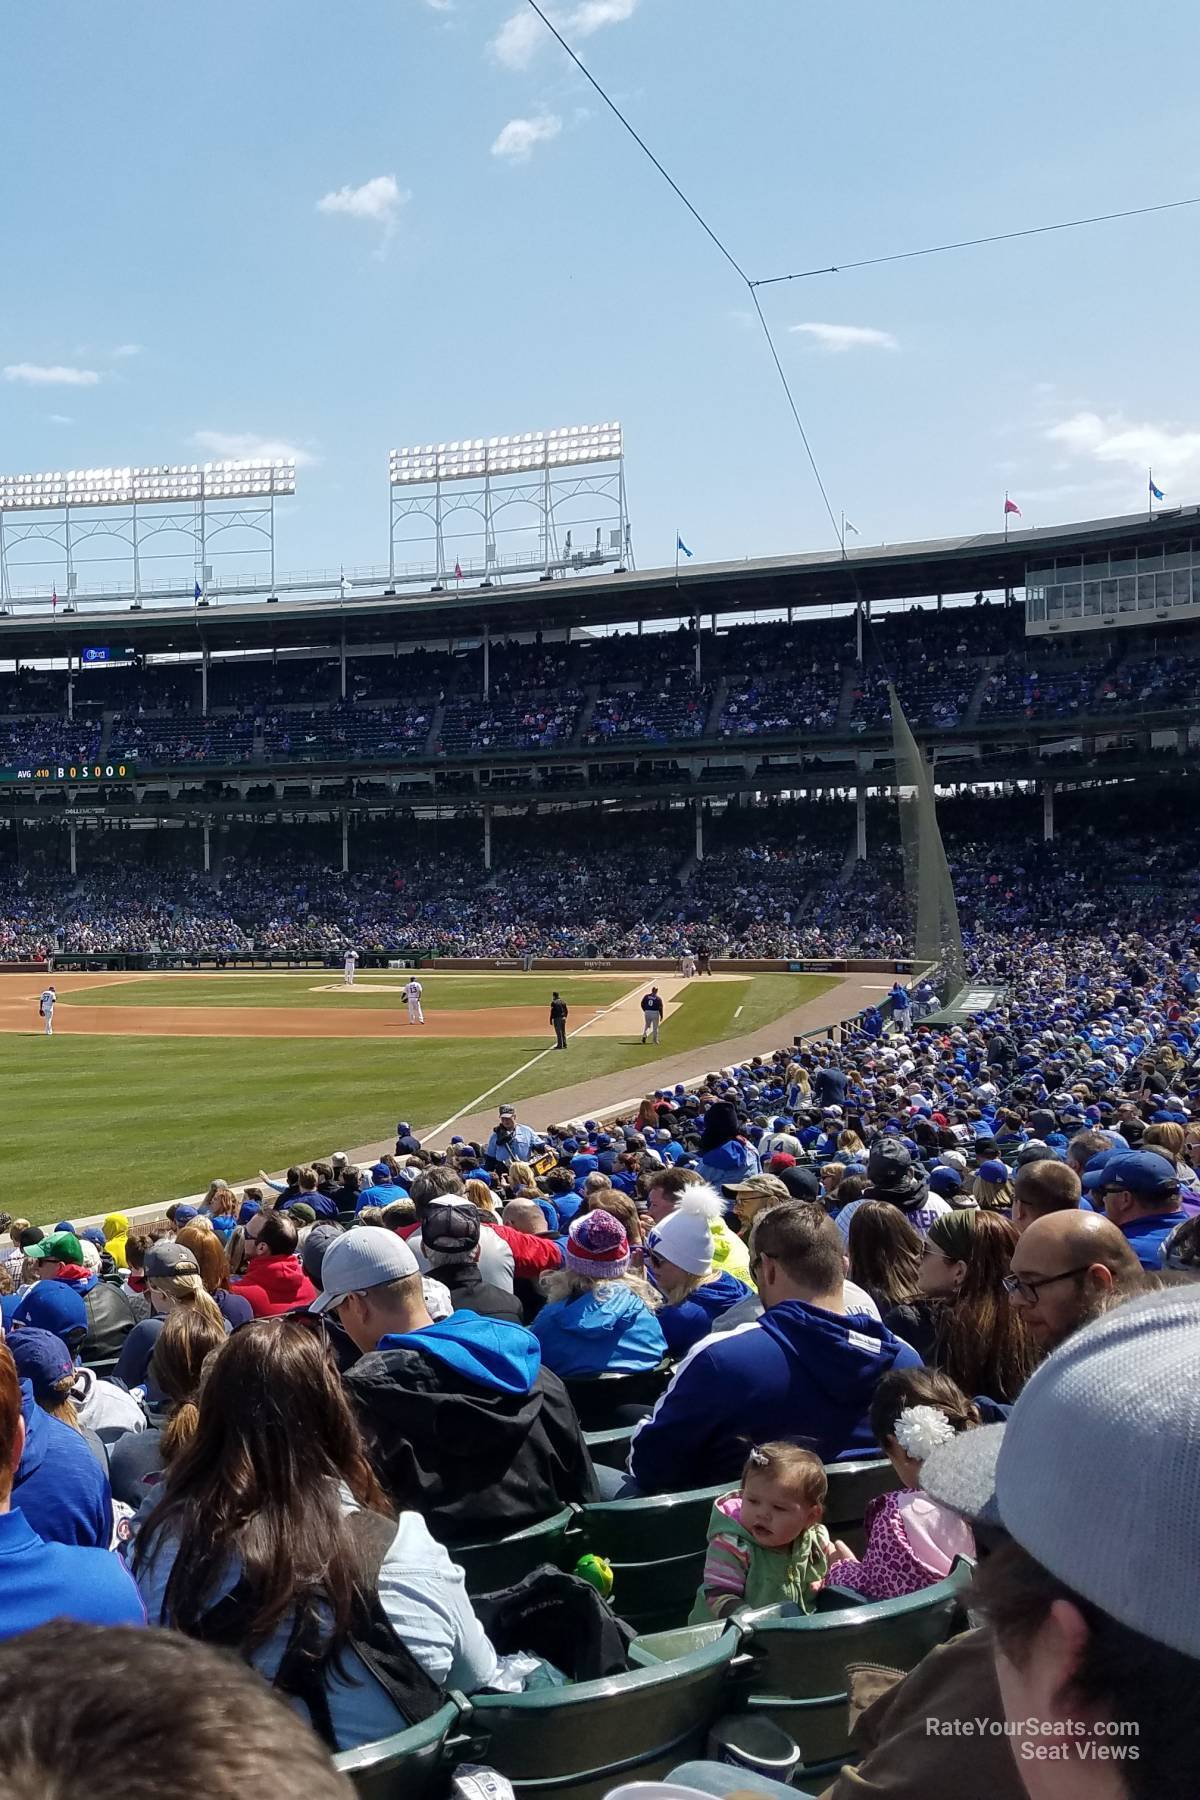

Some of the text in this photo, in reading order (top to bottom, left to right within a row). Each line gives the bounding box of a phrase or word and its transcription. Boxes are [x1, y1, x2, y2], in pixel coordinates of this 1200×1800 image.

[17, 770, 31, 778] AVG
[34, 769, 49, 778] .410
[58, 767, 64, 778] B
[70, 767, 77, 778] 0
[82, 767, 88, 777] S
[95, 766, 101, 777] 0
[119, 766, 126, 776] 0
[767, 1140, 784, 1152] 14
